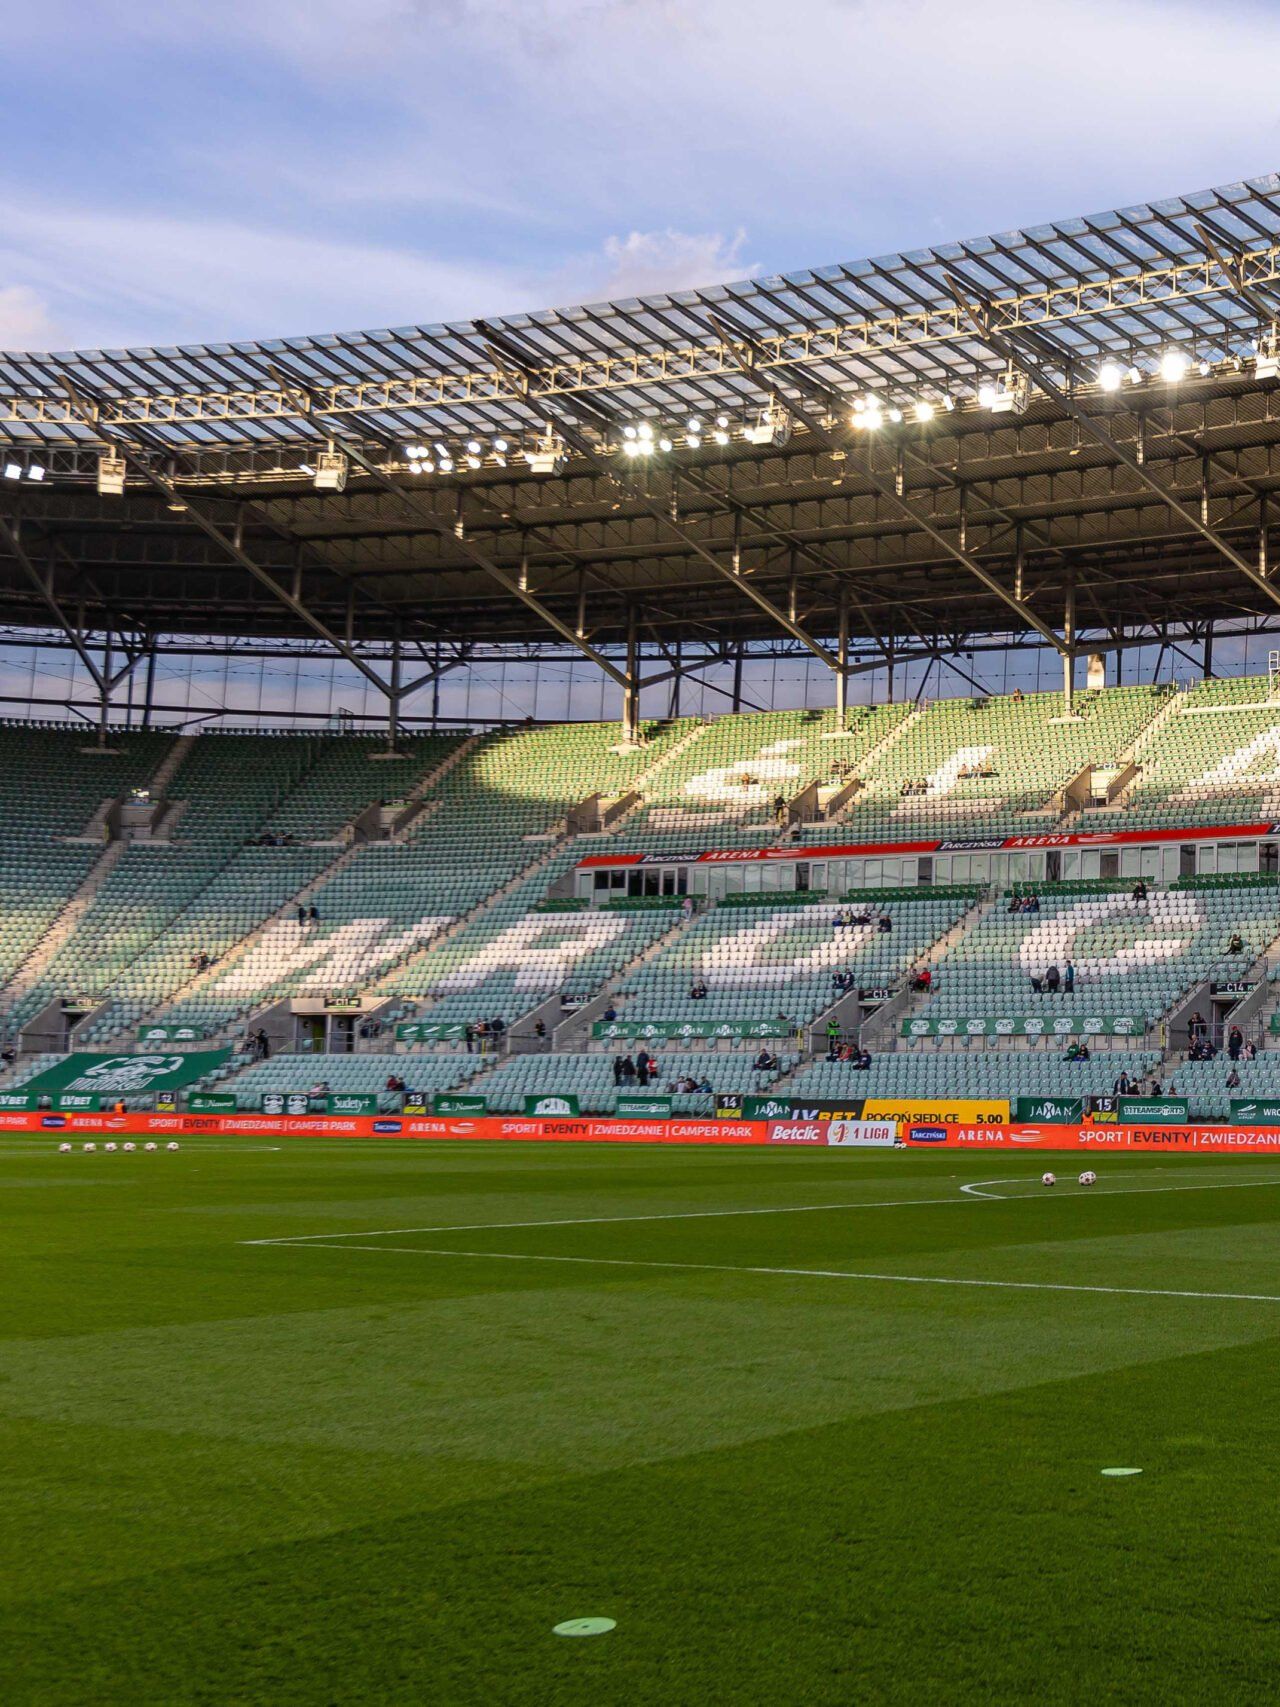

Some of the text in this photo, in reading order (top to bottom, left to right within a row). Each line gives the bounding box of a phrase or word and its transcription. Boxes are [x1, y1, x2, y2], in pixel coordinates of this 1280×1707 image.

[1012, 836, 1070, 847] ARENA
[708, 850, 760, 860] ARENA
[1226, 983, 1244, 992] C14
[873, 990, 888, 999] C13
[408, 1094, 423, 1105] 13
[722, 1096, 737, 1108] 14
[1096, 1098, 1112, 1111] 15
[866, 1111, 1003, 1124] POGOŃ SIEDLCE 5.00
[148, 1118, 178, 1128] SPORT
[331, 1121, 356, 1131] PARK
[409, 1123, 446, 1132] ARENA
[501, 1123, 752, 1137] SPORT EVENTY ZWIEDZANIE CAMPER PARK
[772, 1125, 821, 1140] Betclic
[853, 1128, 889, 1140] 1 LIGA
[957, 1130, 1004, 1141] ARENA
[1078, 1131, 1124, 1142] SPORT
[1133, 1131, 1191, 1143] EVENTY
